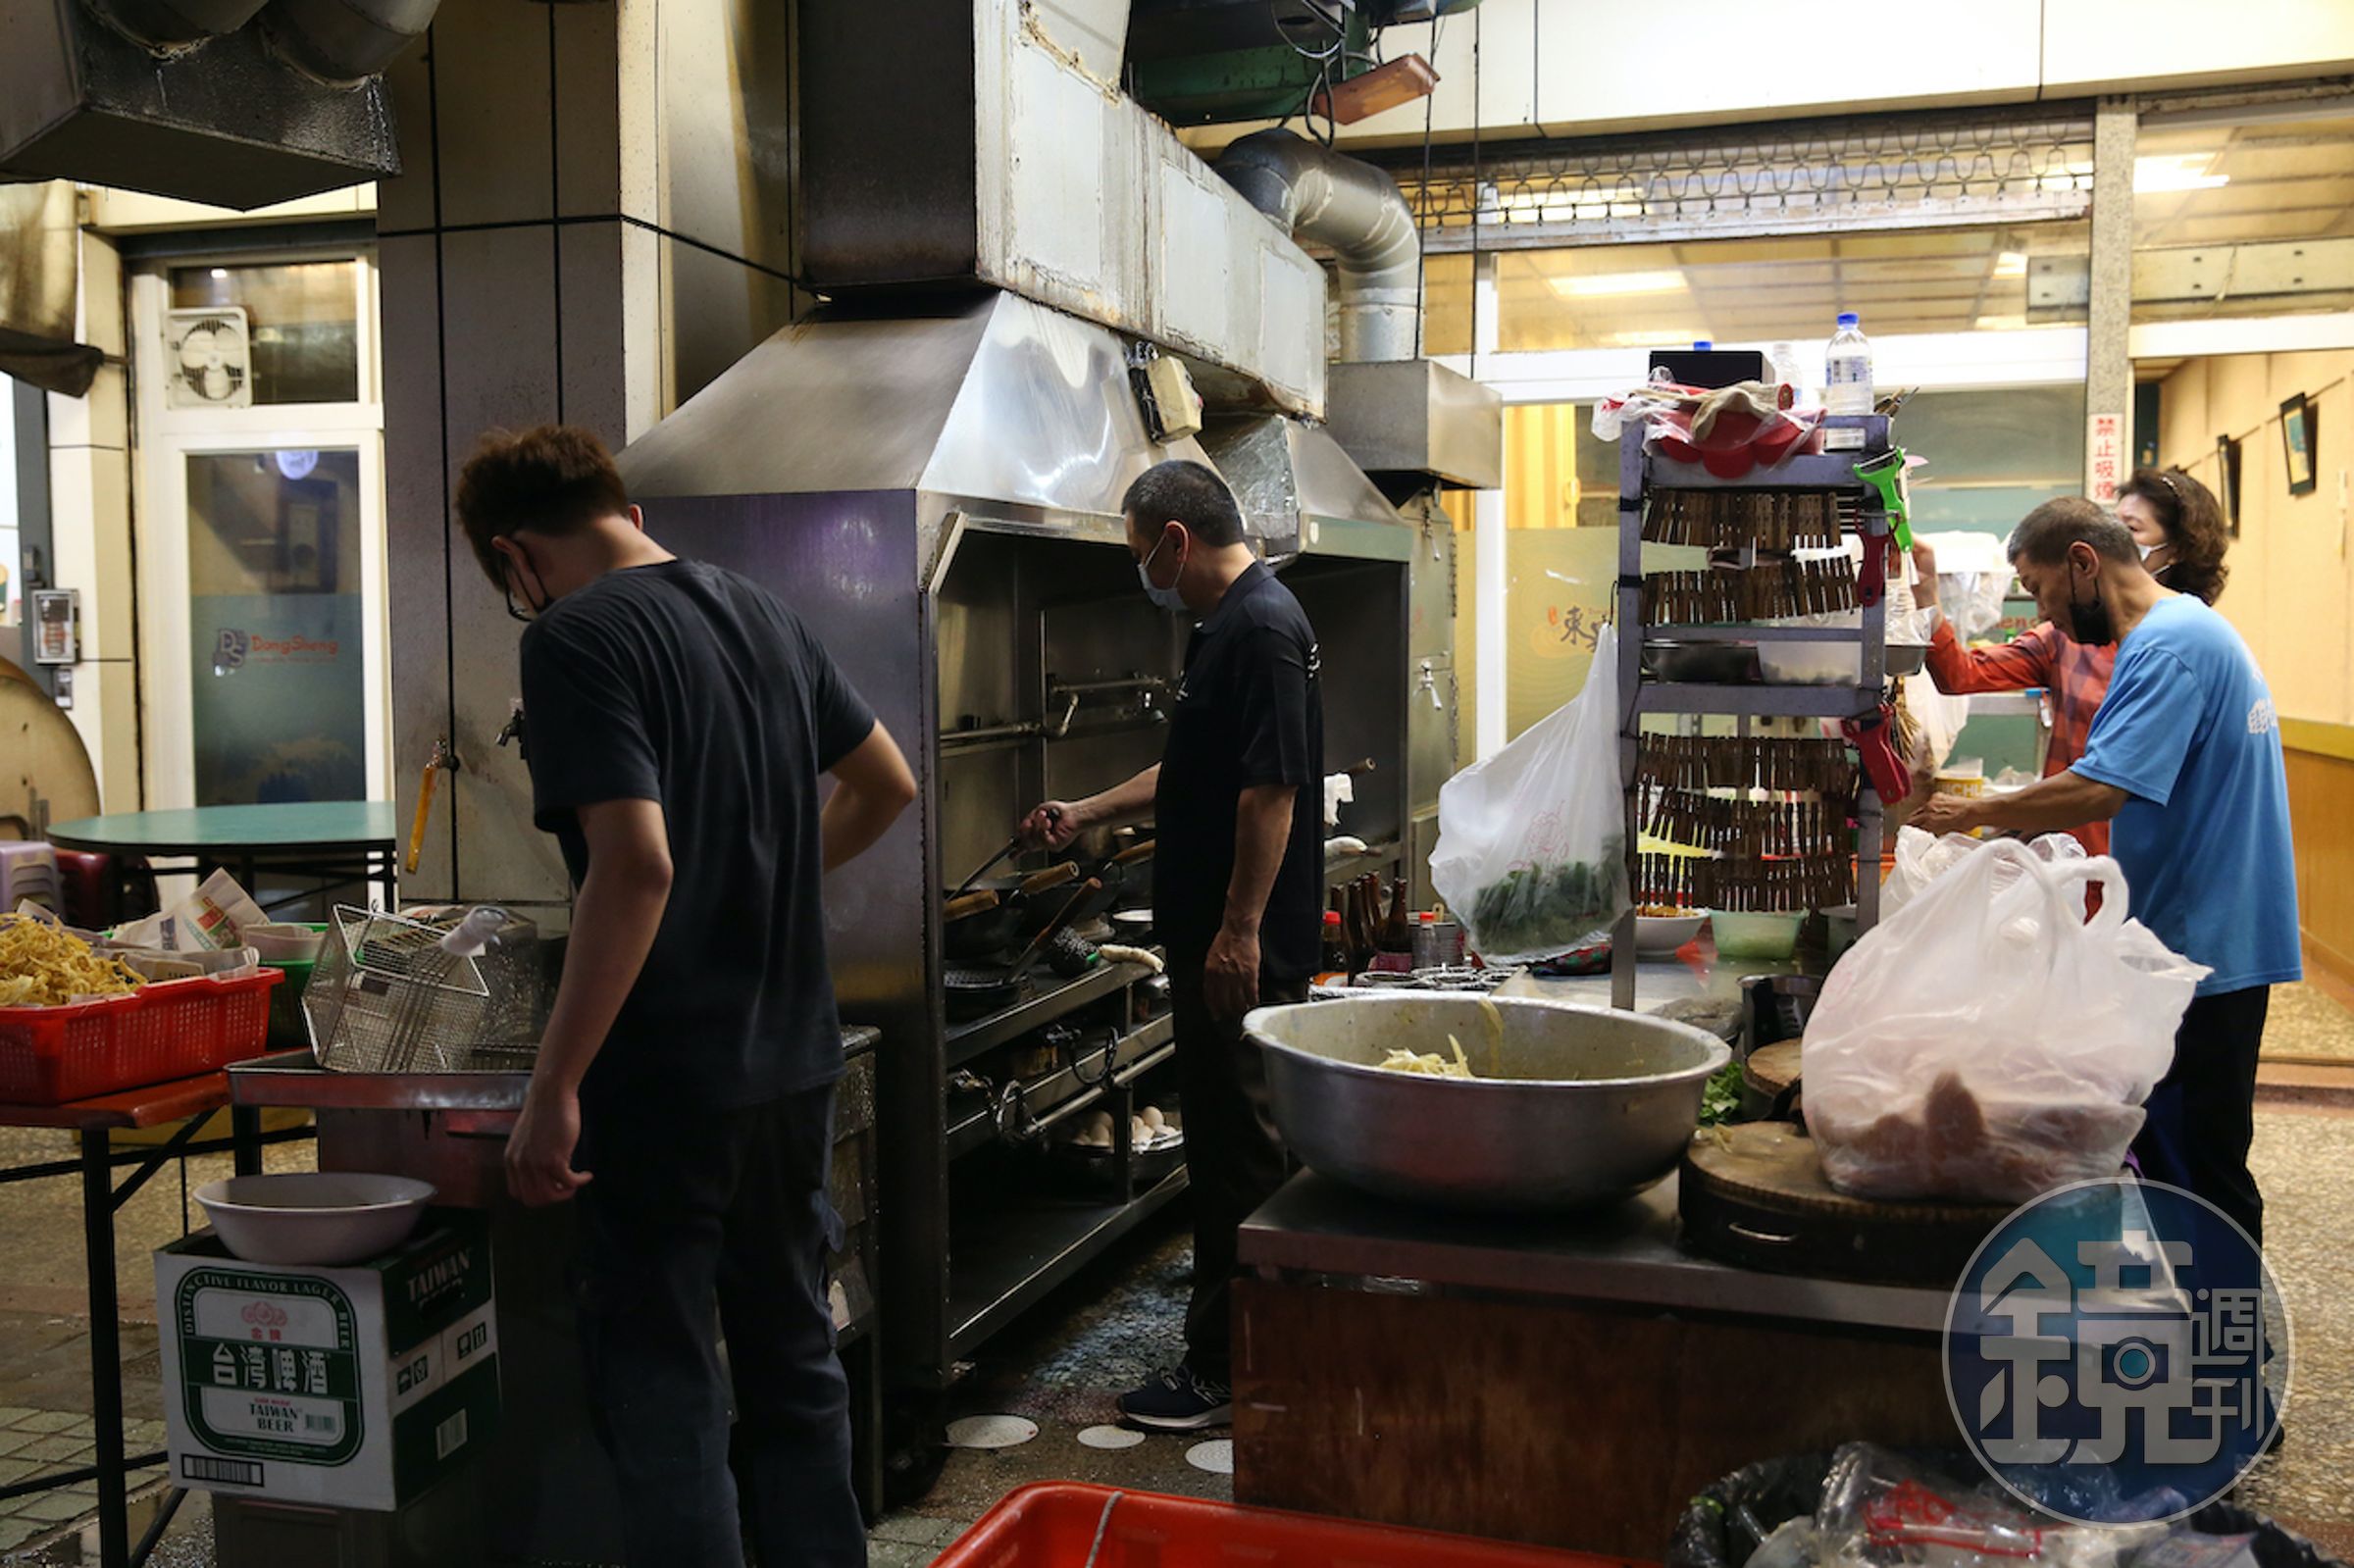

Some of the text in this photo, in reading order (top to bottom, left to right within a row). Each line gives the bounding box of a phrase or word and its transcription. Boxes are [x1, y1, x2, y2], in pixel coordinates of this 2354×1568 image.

[2094, 418, 2115, 499] 禁止吸煙
[407, 1251, 471, 1302] TAIWAN
[183, 1275, 350, 1348] DISTINCTIVE FLAVOR LAGER BEER
[249, 1403, 297, 1419] TAIWAN
[257, 1418, 293, 1433] BEER
